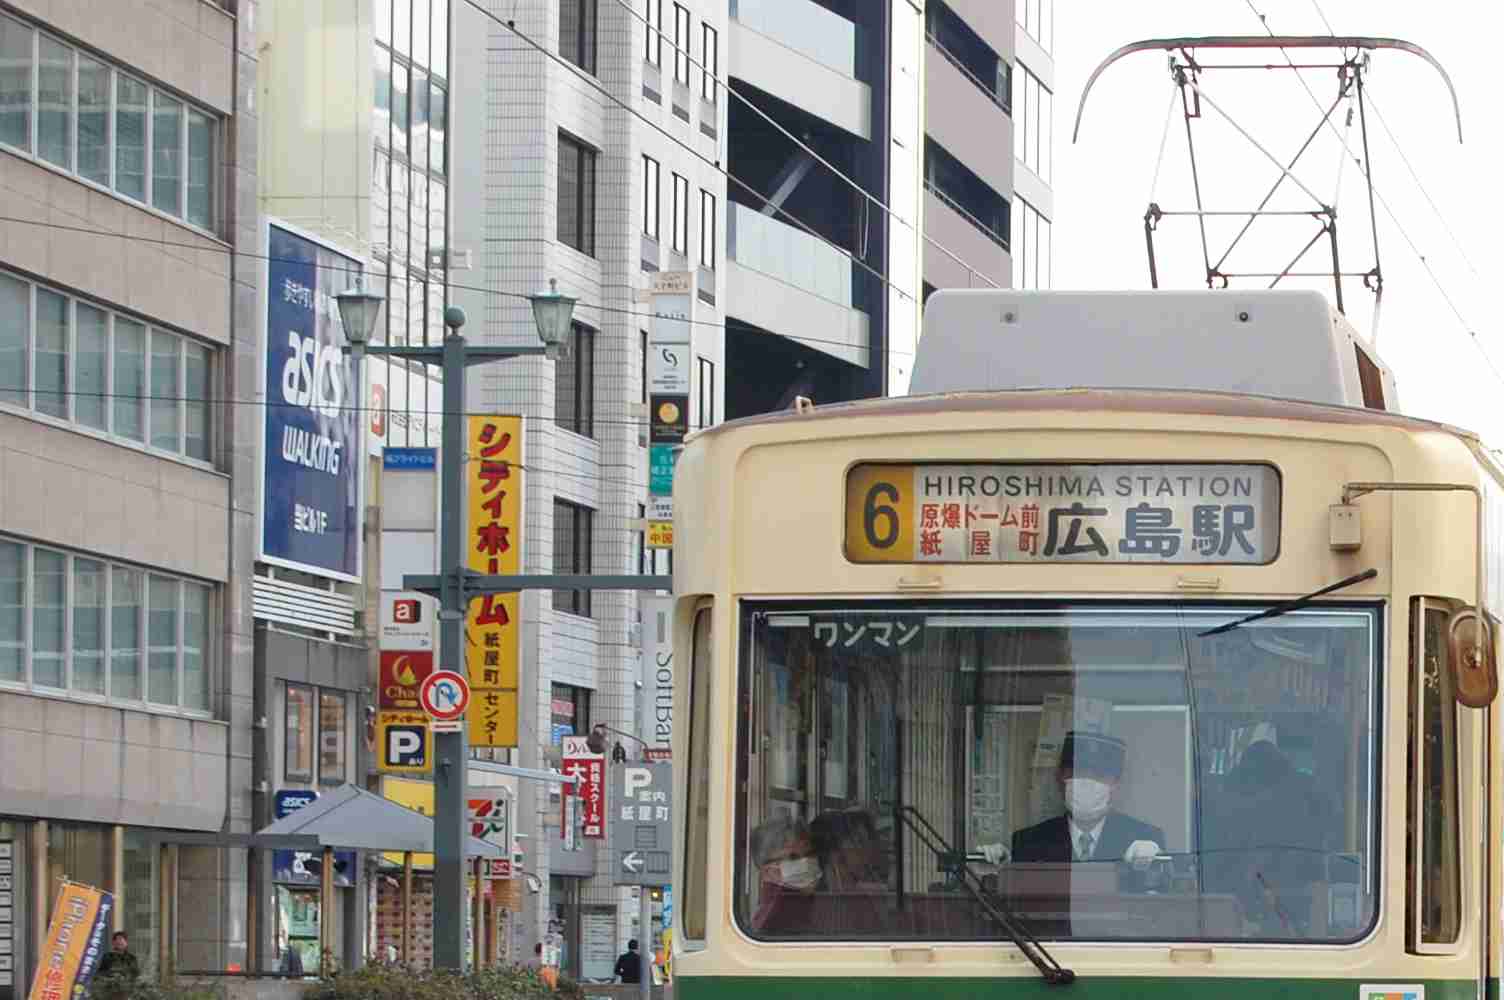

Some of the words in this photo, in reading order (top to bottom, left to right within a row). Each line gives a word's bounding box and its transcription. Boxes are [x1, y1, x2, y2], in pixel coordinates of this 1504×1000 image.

[283, 331, 342, 417] asics
[283, 424, 341, 475] WALKING
[924, 475, 1105, 498] HIROSHIMA
[1115, 475, 1253, 498] STATION
[863, 482, 900, 550] 6
[920, 503, 1040, 529] 原爆ドーム前
[1043, 502, 1256, 559] 広島駅
[920, 530, 1040, 558] 紙屋町
[812, 622, 922, 648] ワンマン
[484, 692, 499, 744] センター
[389, 730, 421, 764] P
